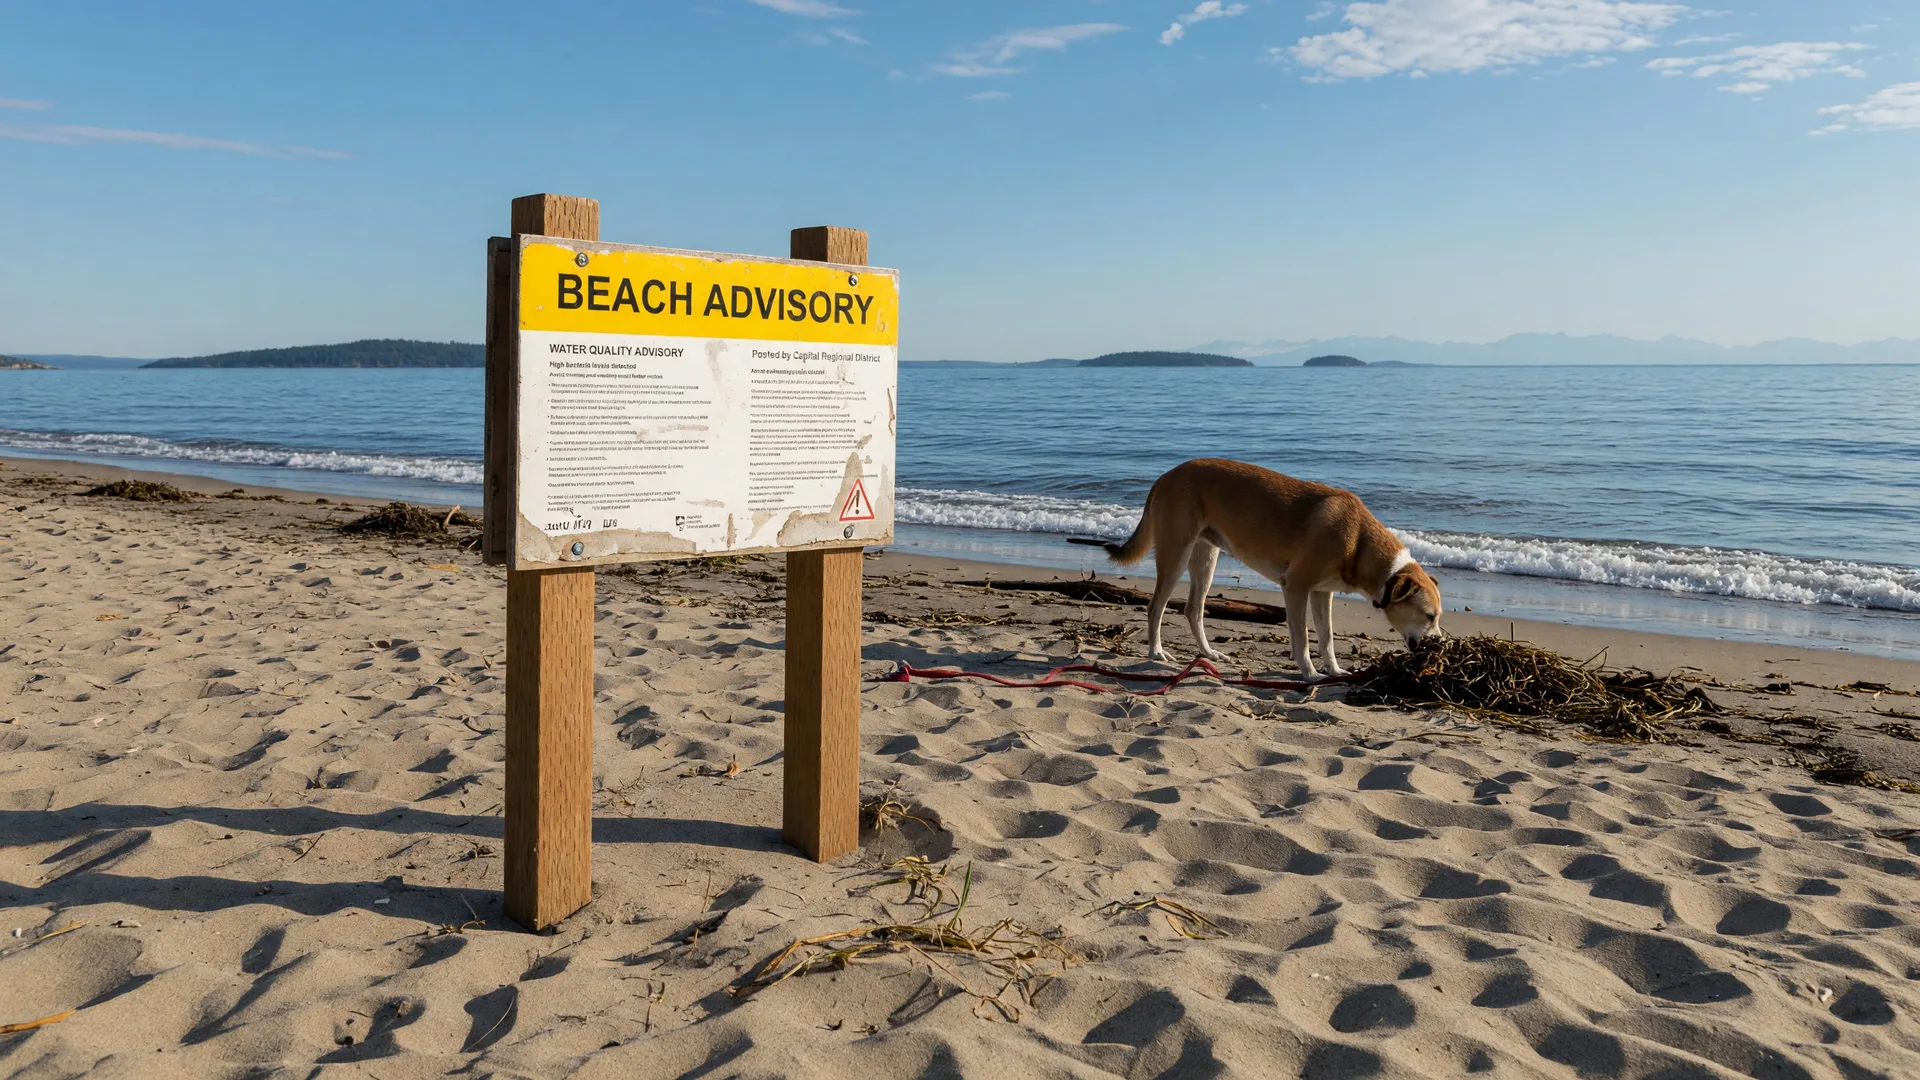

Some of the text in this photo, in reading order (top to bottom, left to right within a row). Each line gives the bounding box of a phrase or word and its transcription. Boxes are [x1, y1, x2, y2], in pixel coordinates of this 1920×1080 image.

[557, 273, 874, 325] BEACH ADVISORY
[549, 344, 684, 357] WATER QUALITY ADVISORY
[752, 350, 881, 362] Posted by Capital Regional District
[549, 361, 565, 369] High
